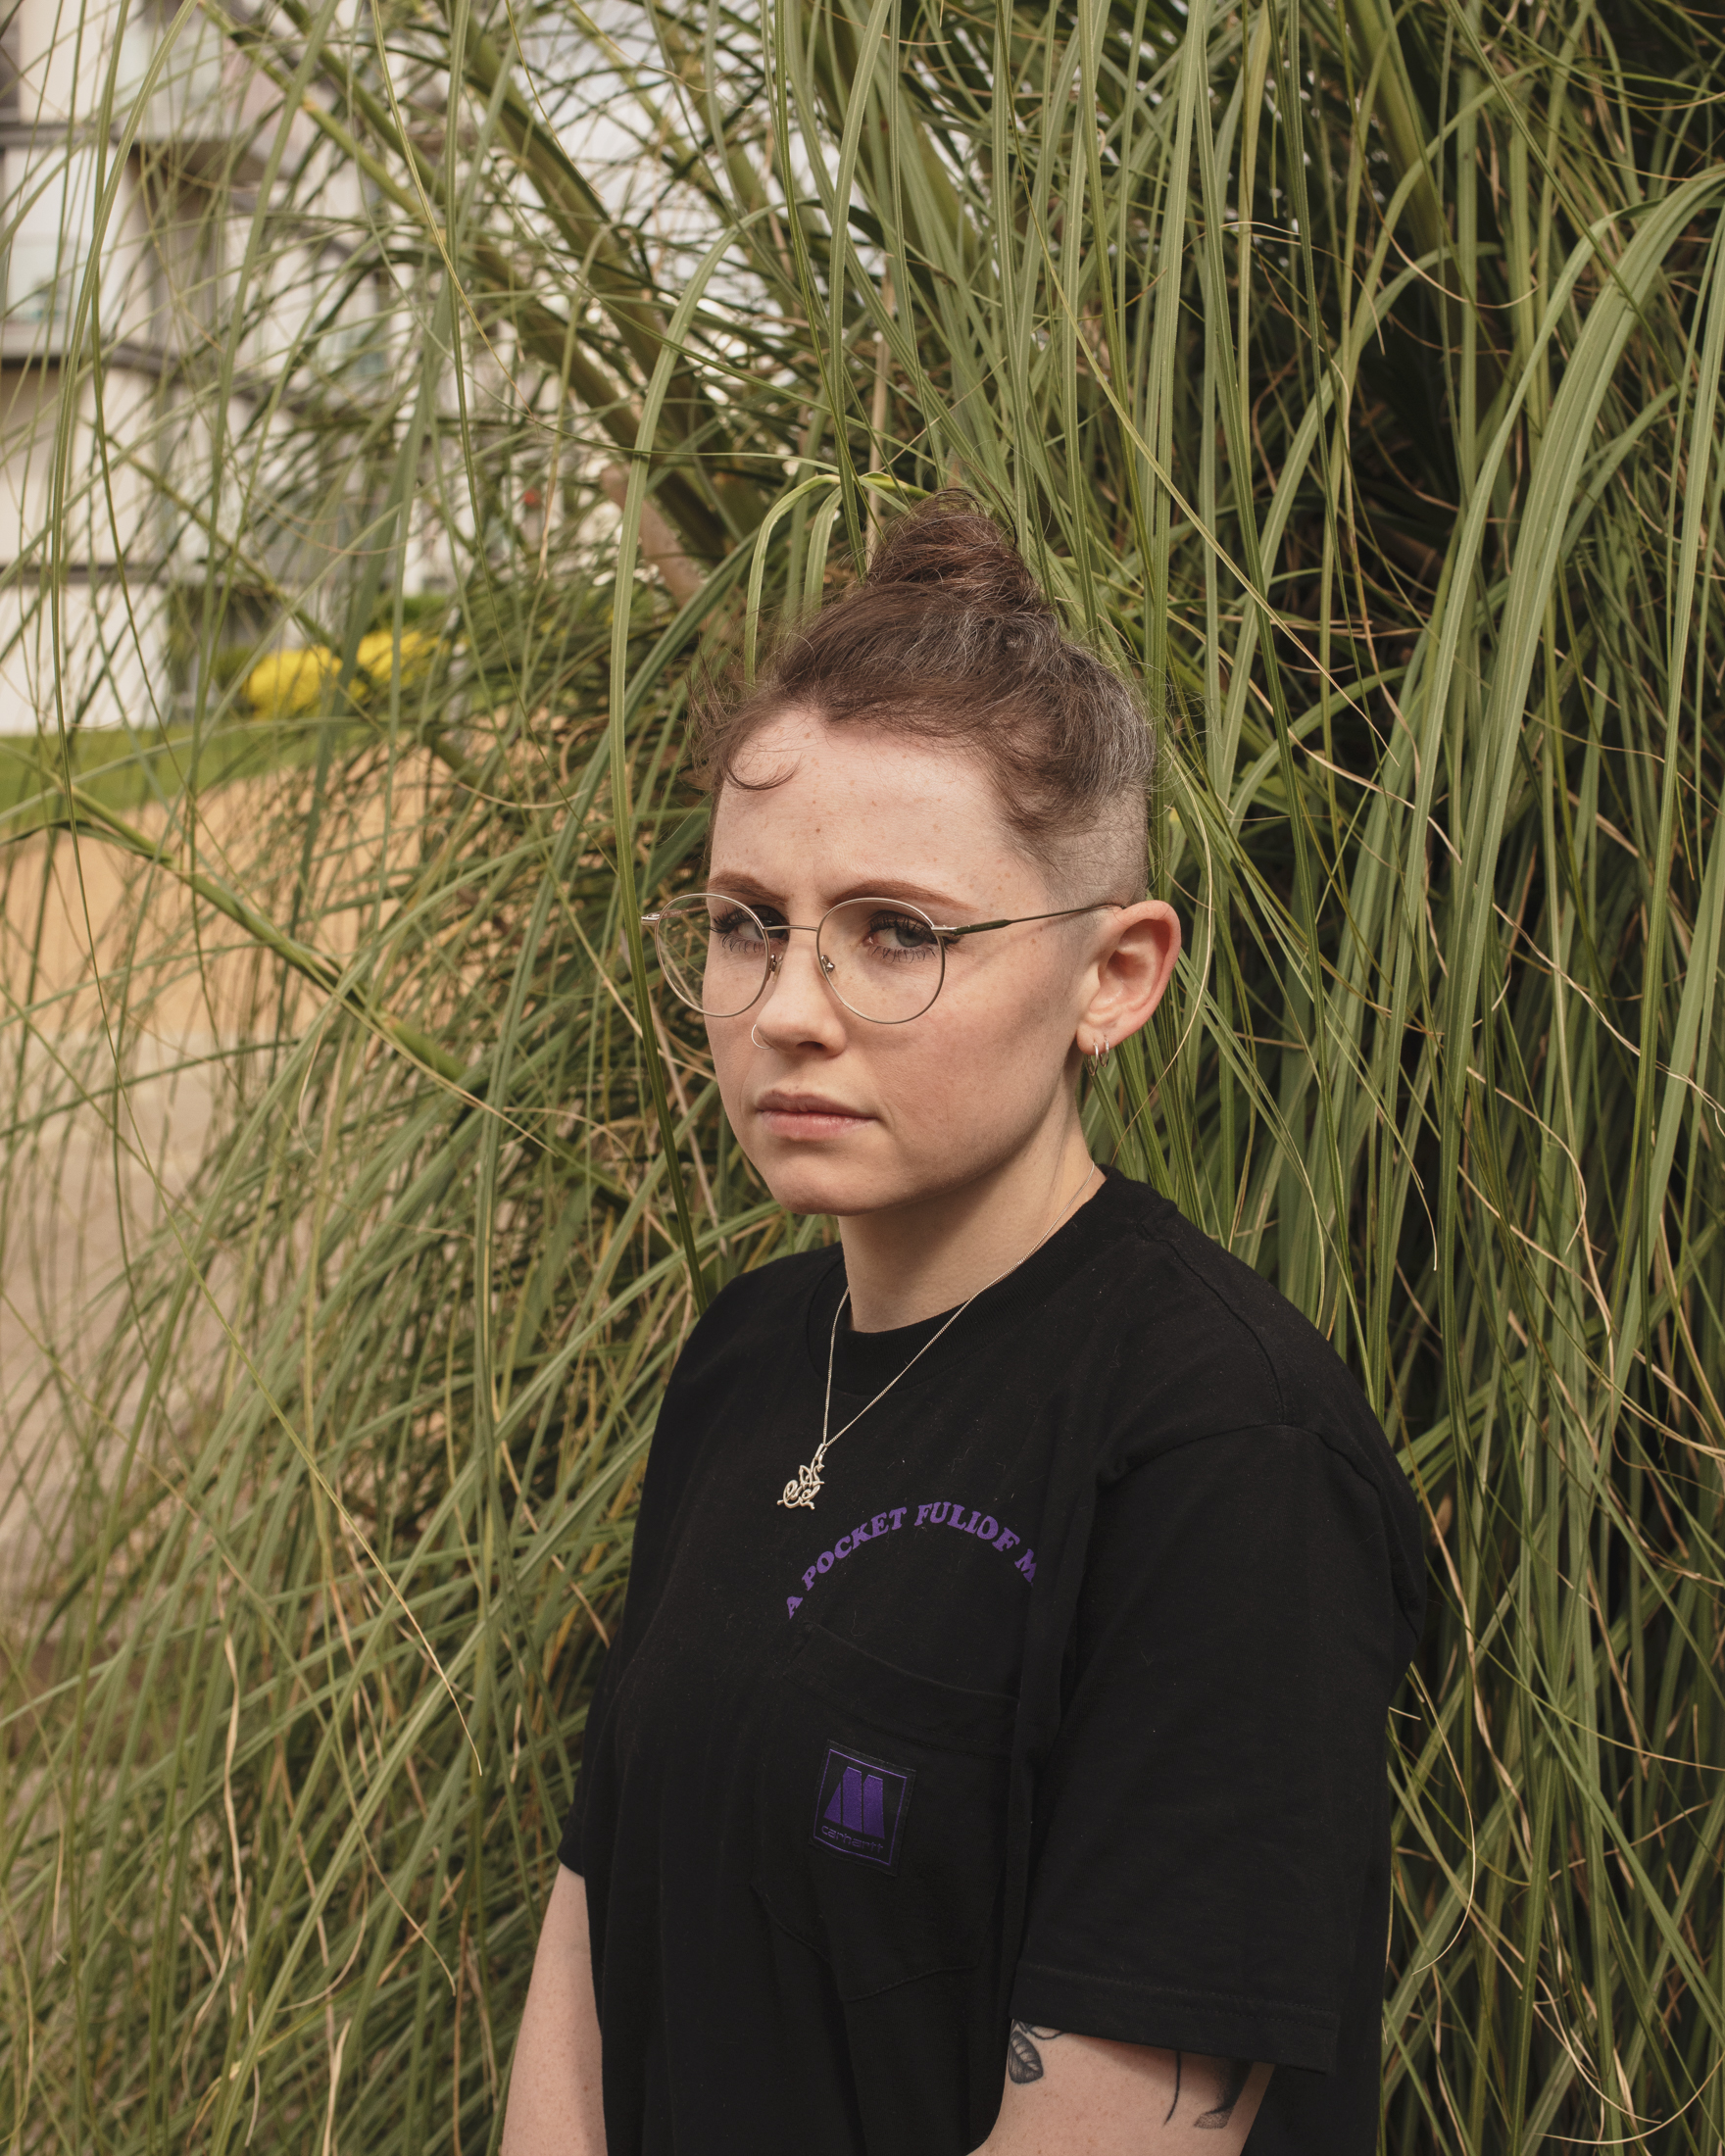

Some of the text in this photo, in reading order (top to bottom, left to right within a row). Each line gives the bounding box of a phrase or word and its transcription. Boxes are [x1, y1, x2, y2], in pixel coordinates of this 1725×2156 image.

[786, 1596, 803, 1619] A
[802, 1506, 907, 1592] POCKET
[821, 1825, 884, 1853] carhartt
